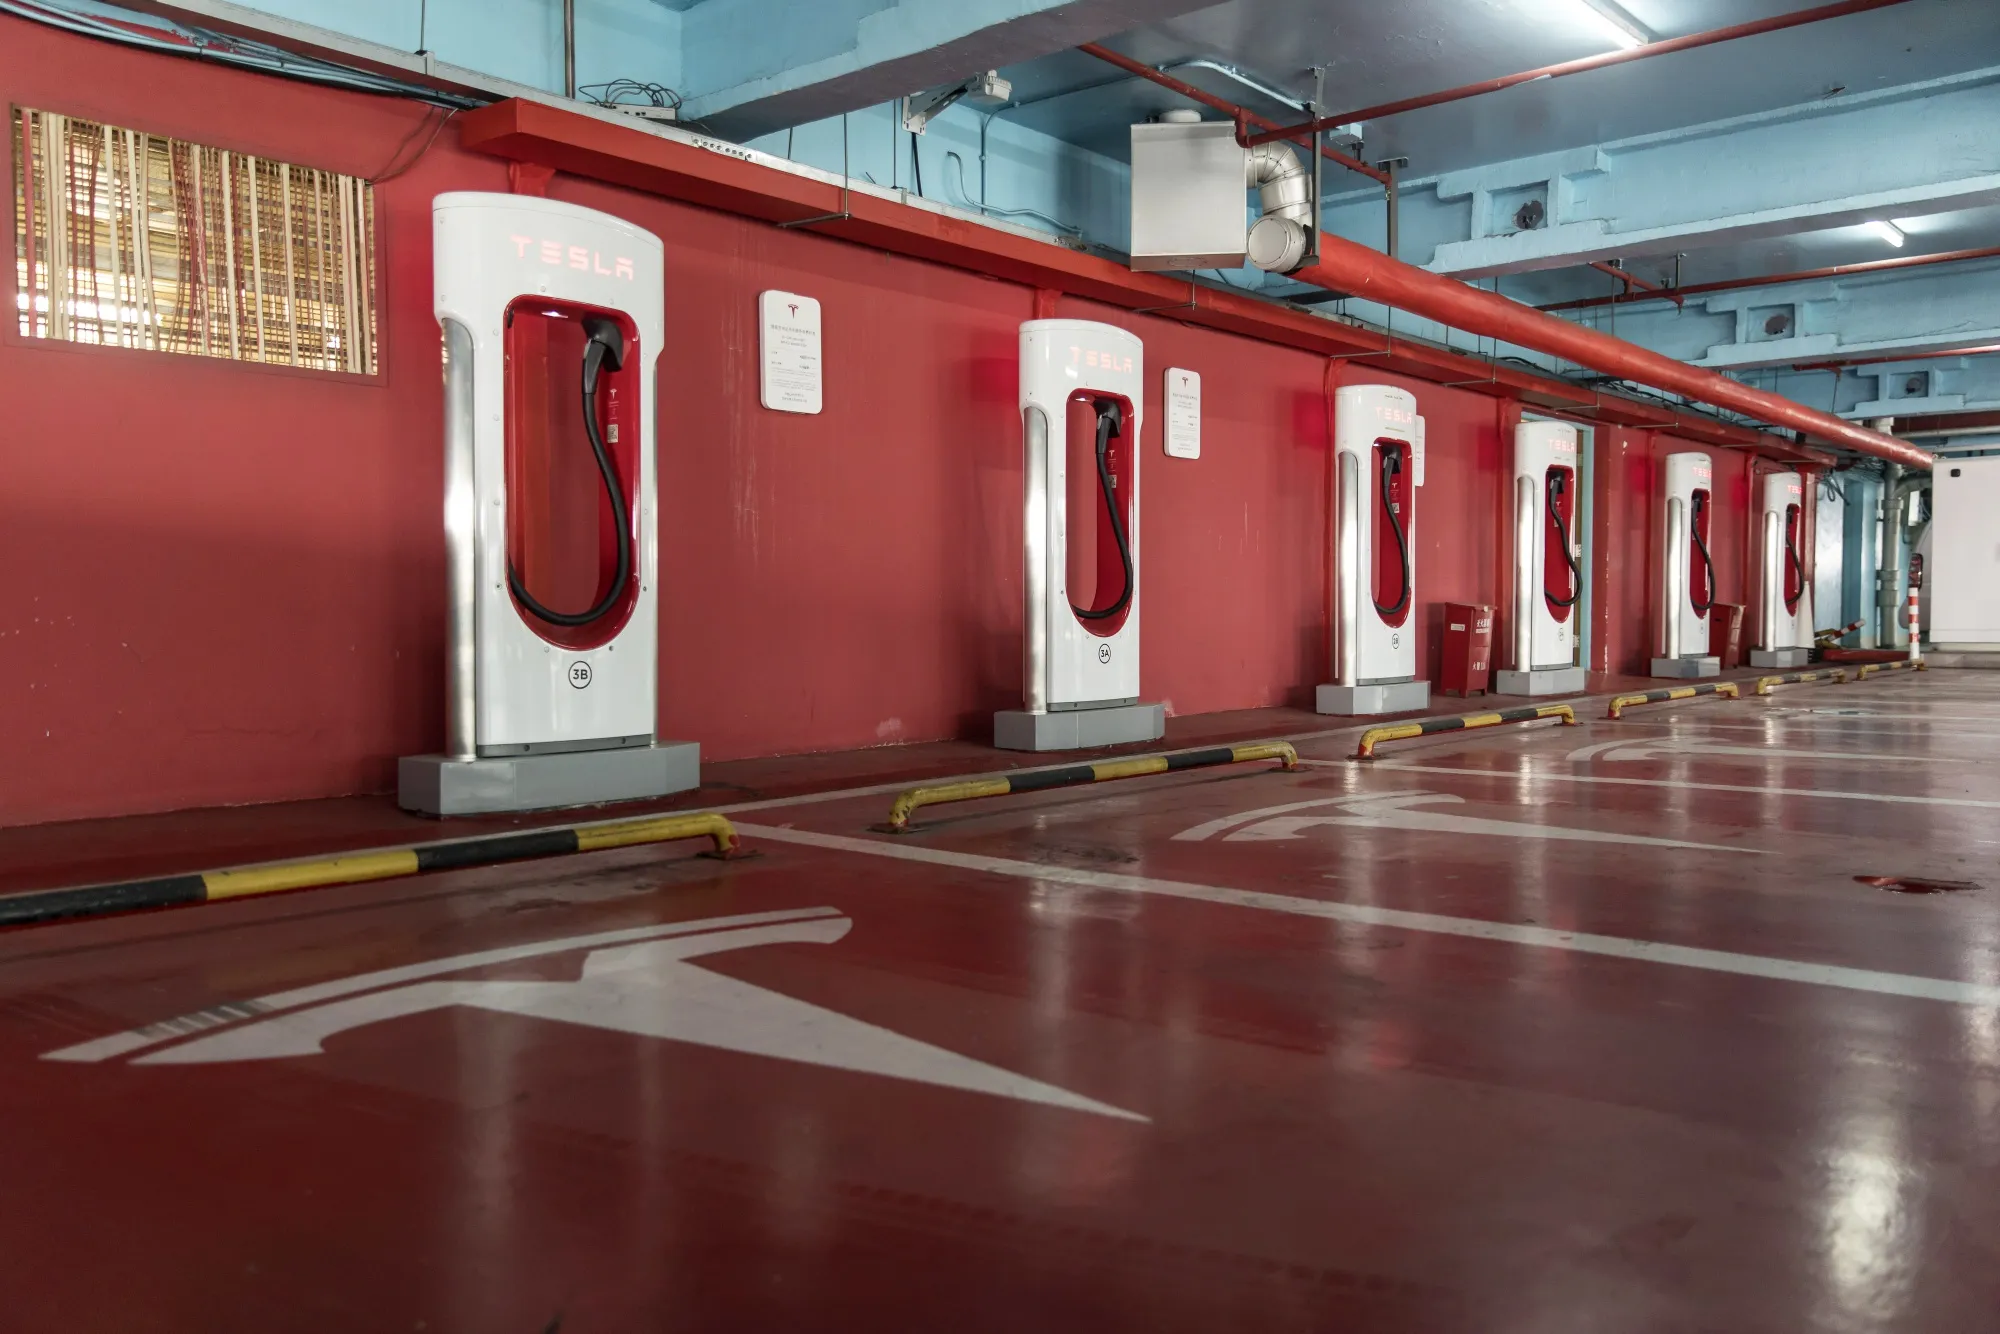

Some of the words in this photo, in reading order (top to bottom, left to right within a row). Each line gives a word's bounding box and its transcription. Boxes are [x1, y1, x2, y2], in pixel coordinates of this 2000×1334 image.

[510, 235, 633, 281] TESLA
[1069, 346, 1133, 374] TESLA
[1375, 406, 1412, 424] TESLA
[1100, 649, 1110, 658] 3A
[572, 668, 589, 680] 3B
